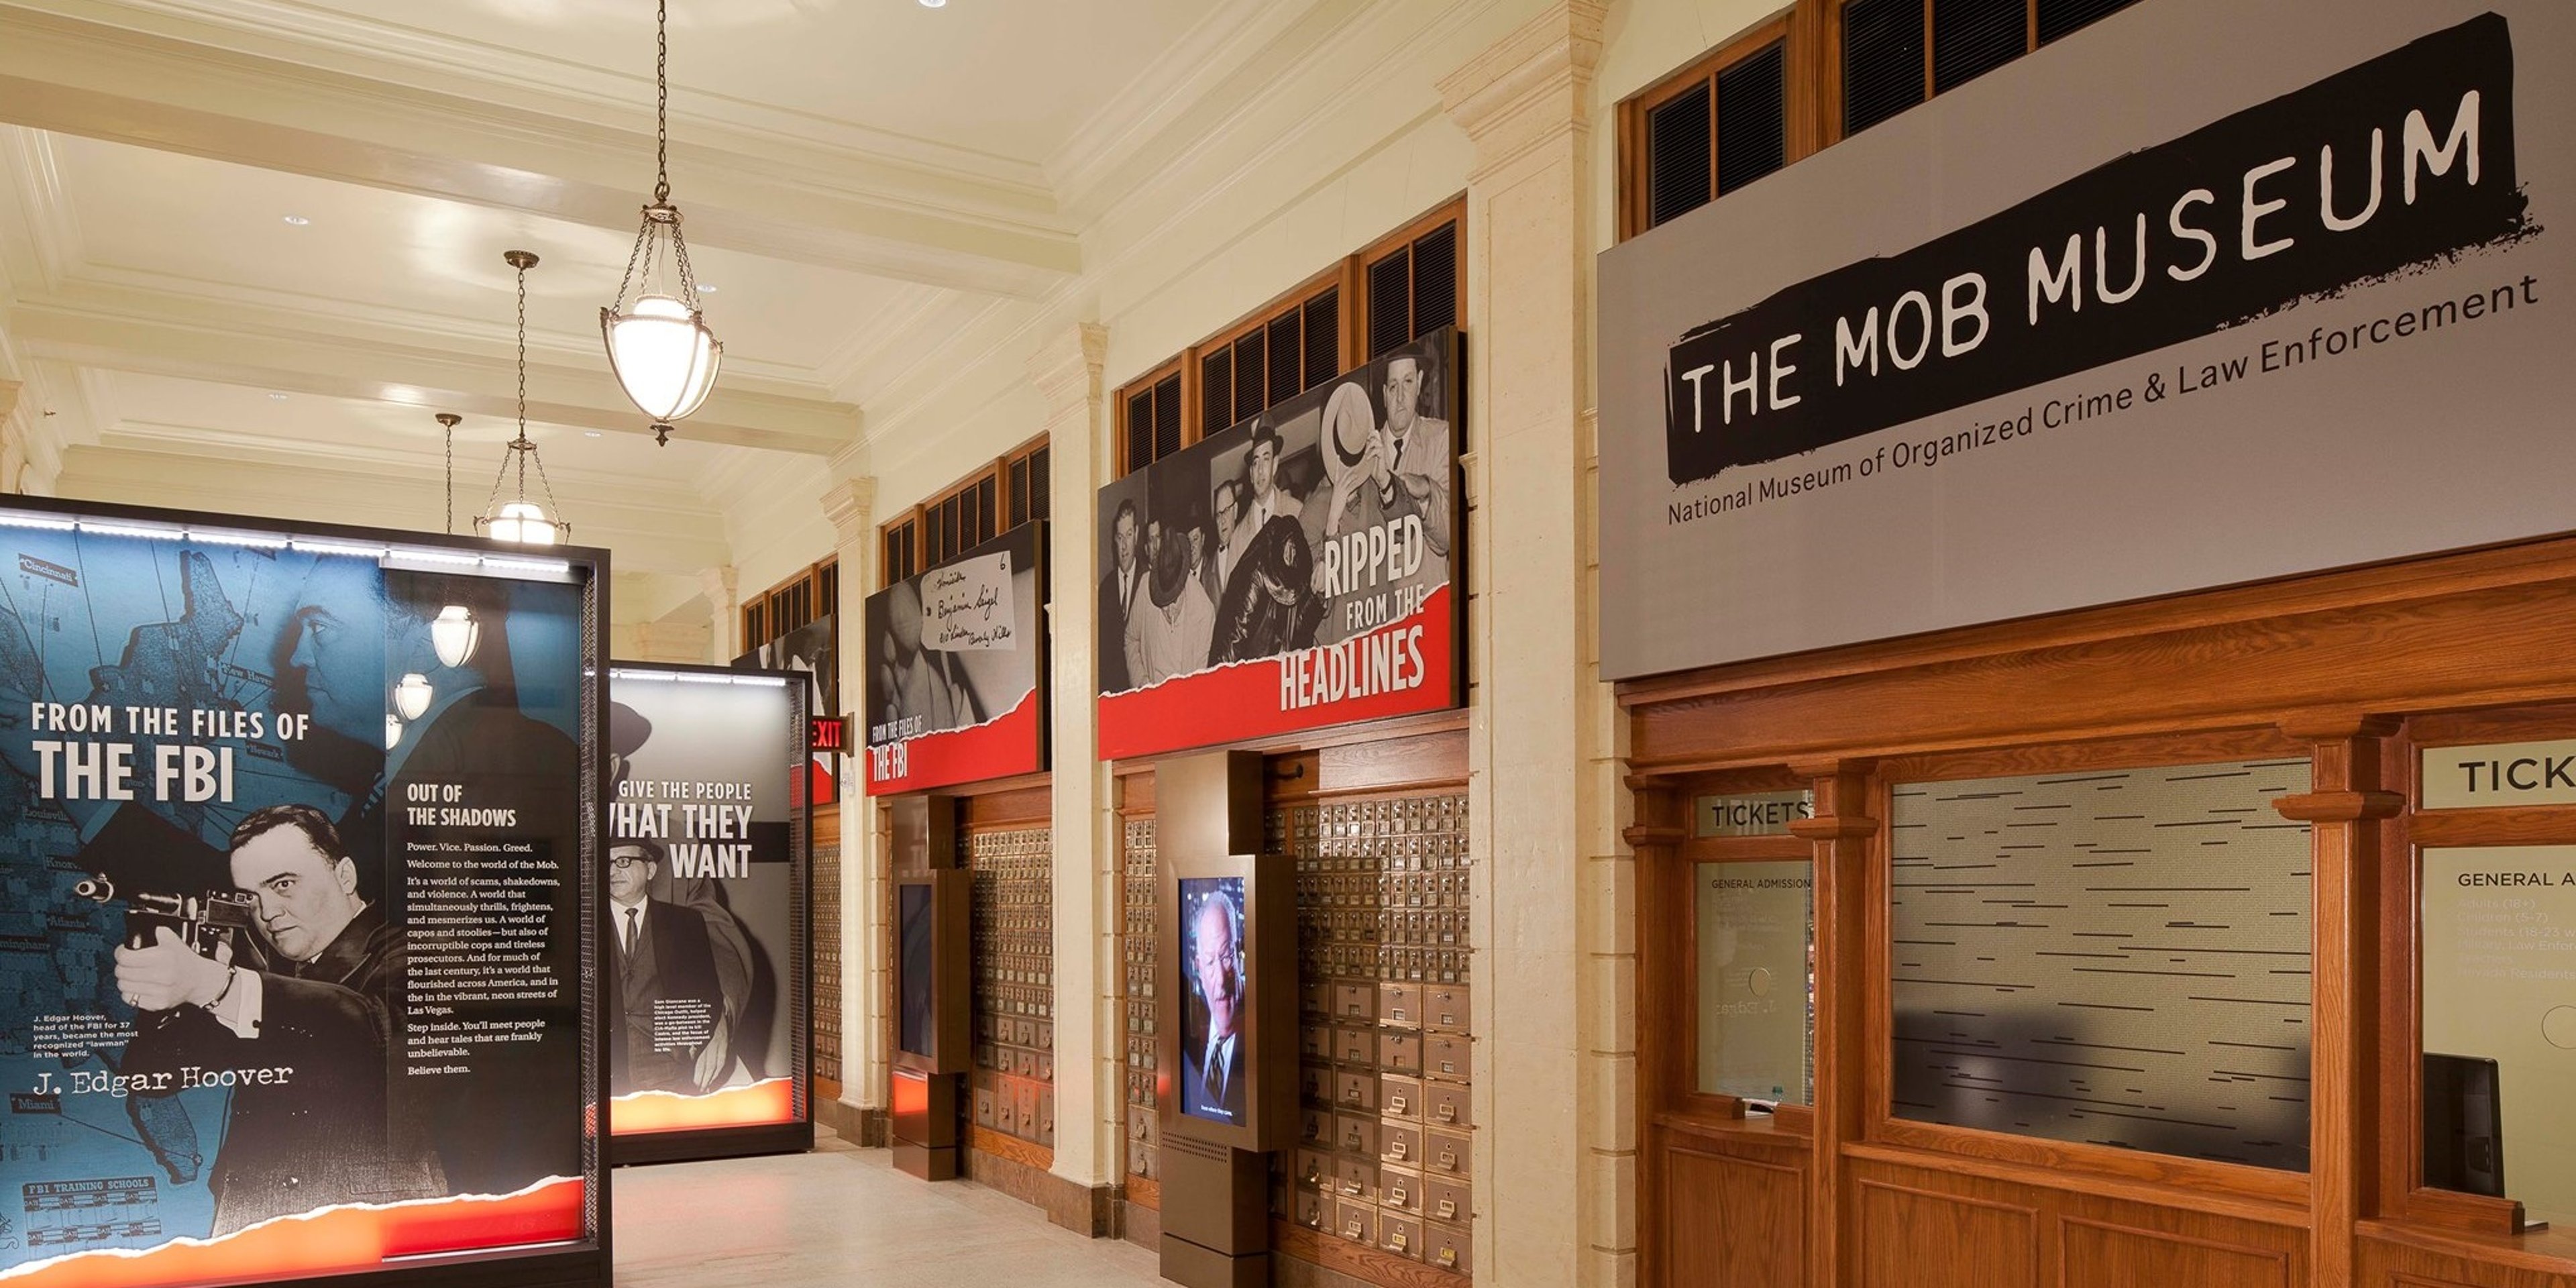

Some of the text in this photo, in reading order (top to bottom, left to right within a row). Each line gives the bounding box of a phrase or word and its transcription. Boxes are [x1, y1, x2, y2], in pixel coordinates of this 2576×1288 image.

[1680, 90, 2480, 434] THE MOB MUSEUM
[1668, 275, 2539, 526] National Museum of Organized Crime & Law Enforcement
[1000, 553, 1006, 570] 6
[1326, 514, 1424, 598] RIPPED
[1347, 583, 1424, 631] FROM THE
[1281, 625, 1425, 711] HEADLINES
[32, 702, 309, 741] FROM THE FILES OF
[872, 714, 922, 743] FROM THE FILES OF
[872, 740, 908, 782] THE FBI
[32, 740, 233, 803] THE FBI
[2458, 755, 2576, 793] TICK
[407, 783, 463, 803] OUT OF
[619, 780, 752, 800] GIVE THE PEOPLE
[407, 807, 517, 827] THE SHADOWS
[610, 802, 753, 839] HAT THEY
[1712, 801, 1809, 827] TICKETS
[407, 842, 533, 851] Power. Vice. Passion. Greed.
[407, 859, 450, 868] Welcome
[464, 859, 479, 868] the
[480, 860, 507, 868] world
[508, 860, 519, 868] of
[519, 860, 535, 868] the
[536, 860, 559, 869] Mob.
[669, 843, 753, 879] WANT
[407, 876, 421, 885] It's
[429, 876, 457, 885] world
[458, 876, 470, 885] of
[502, 877, 560, 885] shakedowns,
[1711, 877, 1811, 890] GENERAL ADMISSION
[2458, 871, 2576, 886] GENERAL A
[407, 890, 525, 898] and violence. A world that
[407, 902, 553, 912] simultaneously thrills, frightens,
[407, 915, 425, 924] and
[427, 915, 483, 924] mesmerizes
[499, 915, 506, 923] A
[507, 914, 534, 923] world
[535, 914, 546, 923] of
[407, 927, 549, 938] capos and stoolies—but also of
[407, 940, 545, 951] incorruptible cops and tireless
[407, 952, 541, 965] prosecutors. And for much of
[407, 967, 423, 975] the
[425, 967, 441, 975] last
[443, 967, 481, 976] century,
[482, 965, 495, 974] it's
[504, 965, 531, 973] world
[532, 965, 550, 973] that
[407, 979, 455, 989] flourished
[487, 978, 528, 987] America,
[530, 977, 547, 985] and
[549, 977, 558, 985] in
[407, 993, 423, 1002] the
[425, 993, 435, 1001] in
[436, 992, 452, 1001] the
[453, 991, 490, 1000] vibrant,
[547, 989, 557, 998] of
[407, 1006, 453, 1016] Las Vegas.
[407, 1019, 545, 1033] Step inside. You'll meet people
[34, 1040, 83, 1049] recognized
[407, 1036, 426, 1044] and
[427, 1035, 449, 1044] hear
[451, 1034, 473, 1043] tales
[474, 1034, 493, 1042] that
[511, 1032, 542, 1042] frankly
[407, 1047, 470, 1057] unbelievable.
[408, 1065, 471, 1075] Believe them.
[34, 1066, 293, 1097] J. Edgar Hoover
[18, 1098, 55, 1110] Miami
[28, 1179, 149, 1194] FBI TRAINING SCHOOLS
